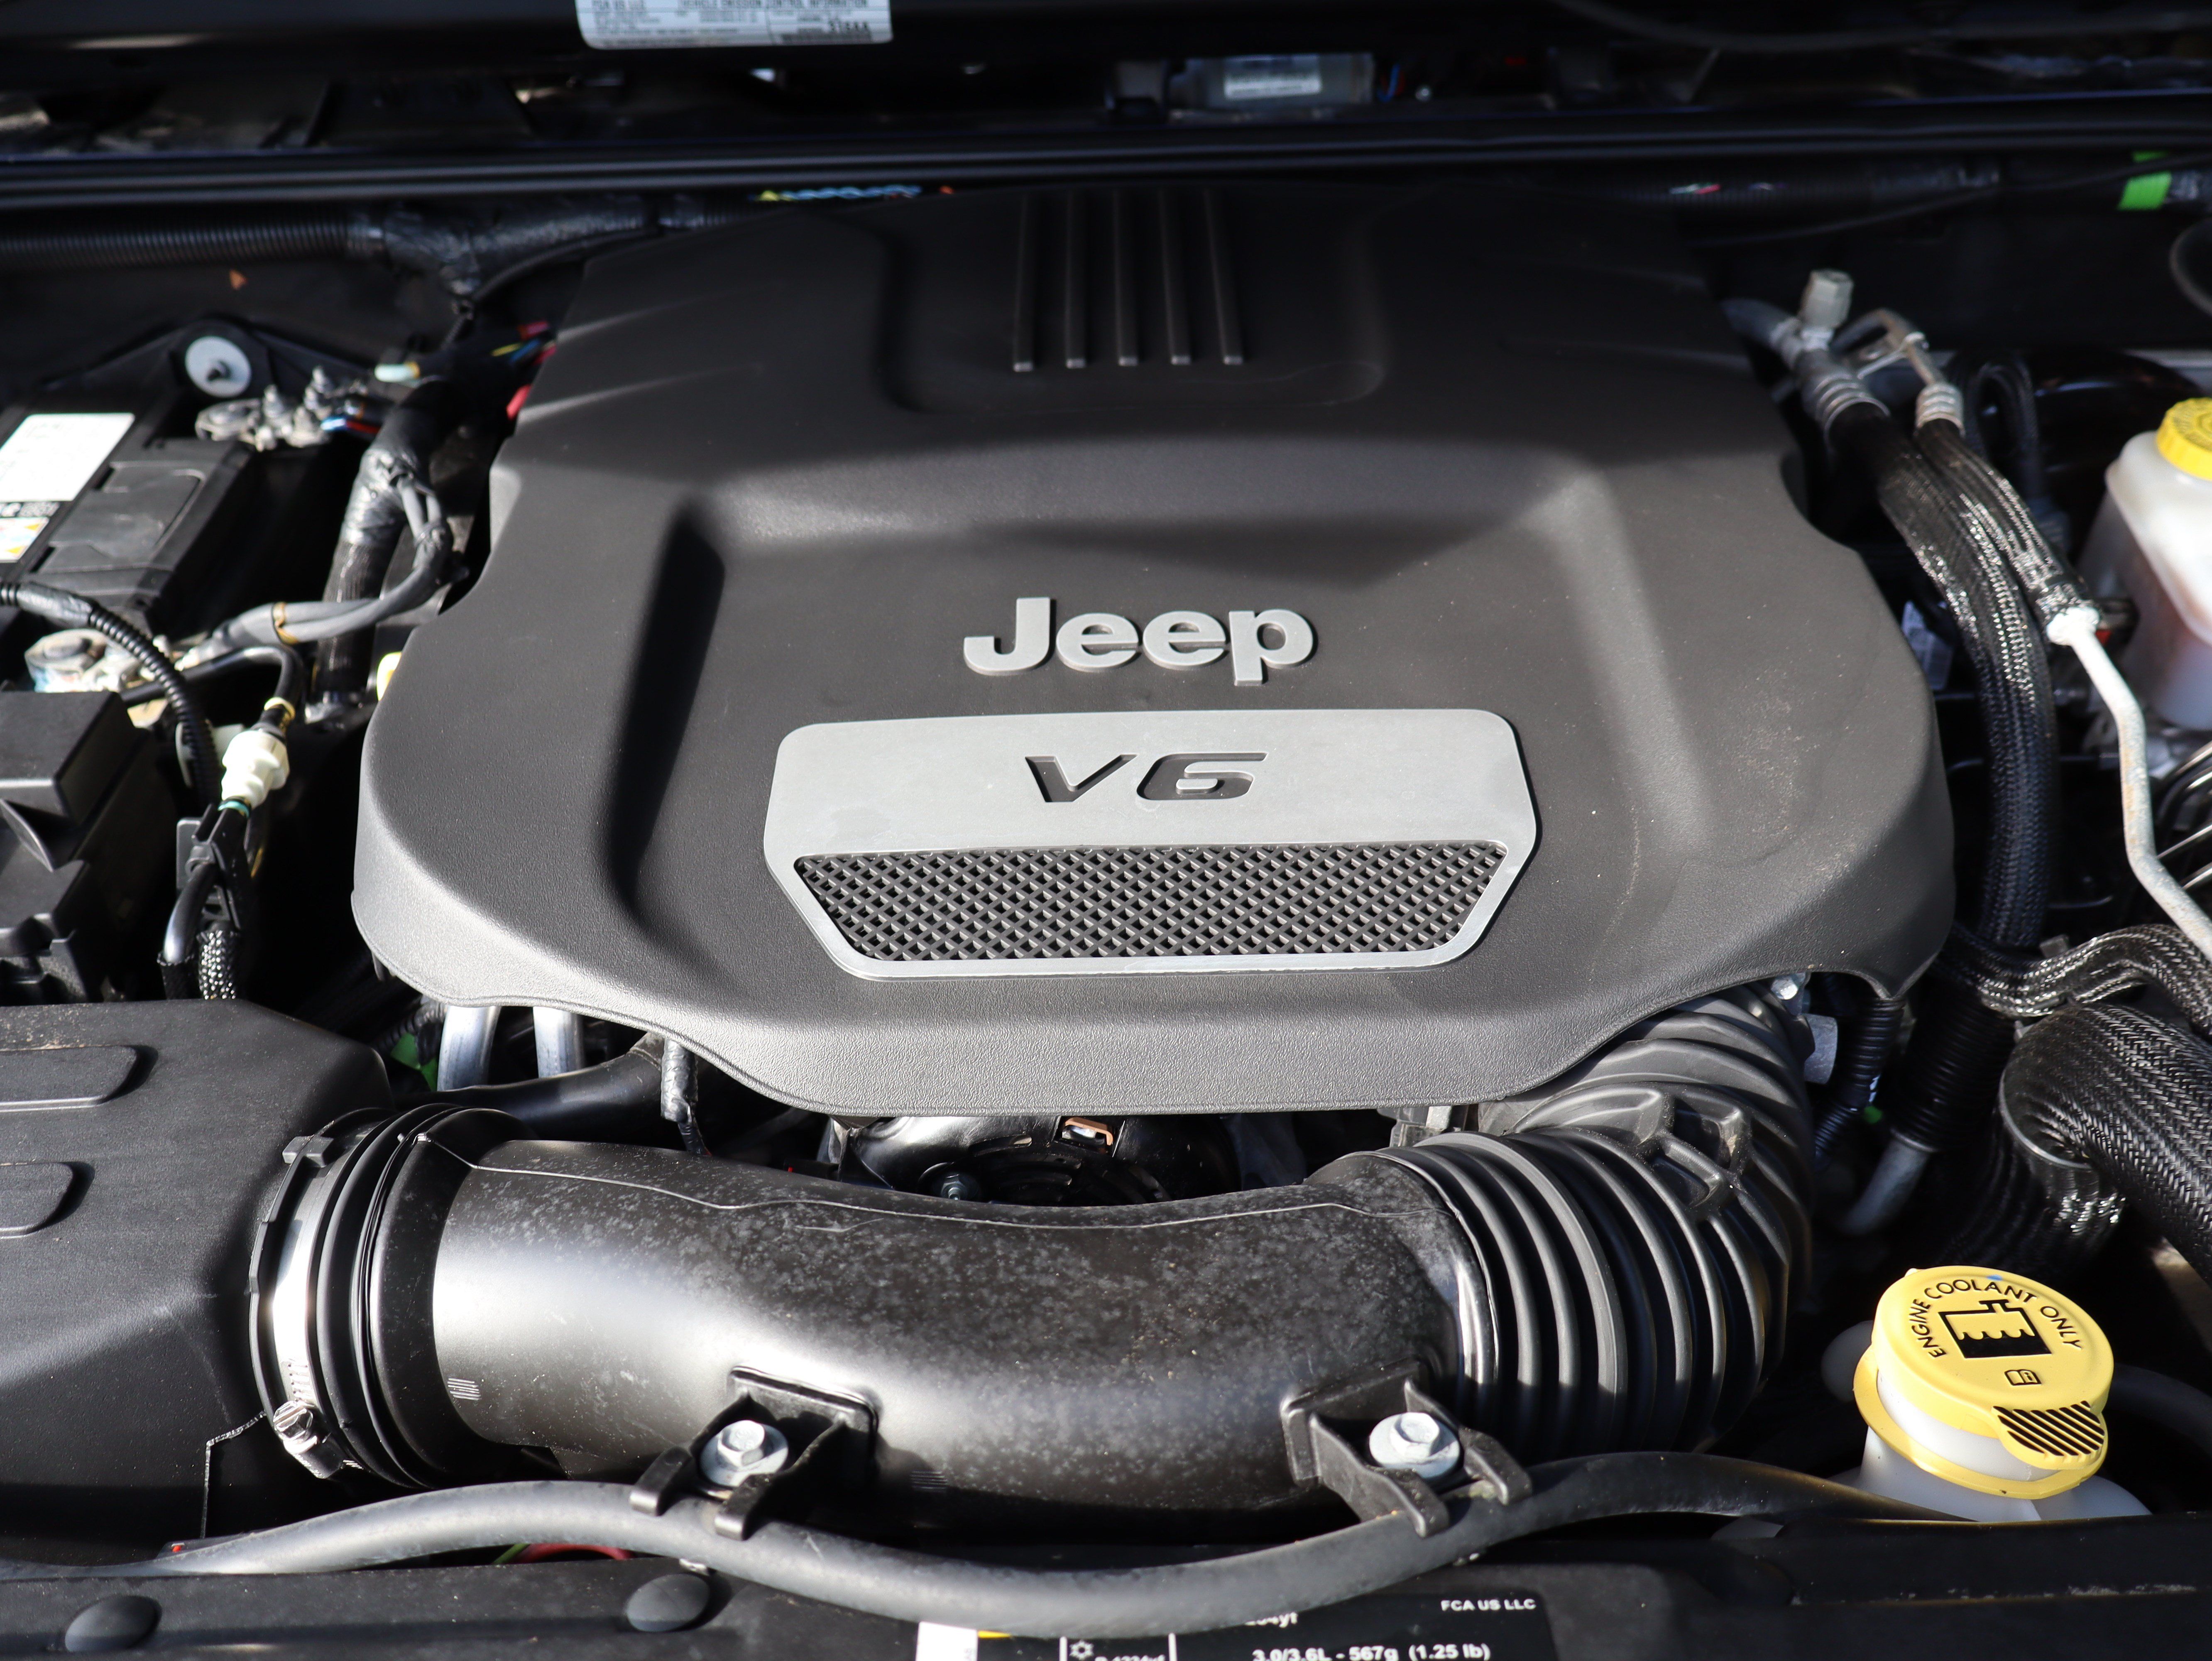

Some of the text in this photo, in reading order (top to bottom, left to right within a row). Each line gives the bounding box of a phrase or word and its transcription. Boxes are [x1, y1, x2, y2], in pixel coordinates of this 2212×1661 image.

[963, 596, 1315, 686] Jeep
[1025, 752, 1268, 802] V6
[1909, 1279, 2082, 1358] ENGINE COOLANT ONLY
[1441, 1599, 1536, 1611] FCA US LLC
[1409, 1644, 1459, 1661] (1.25
[1462, 1643, 1491, 1661] lb)
